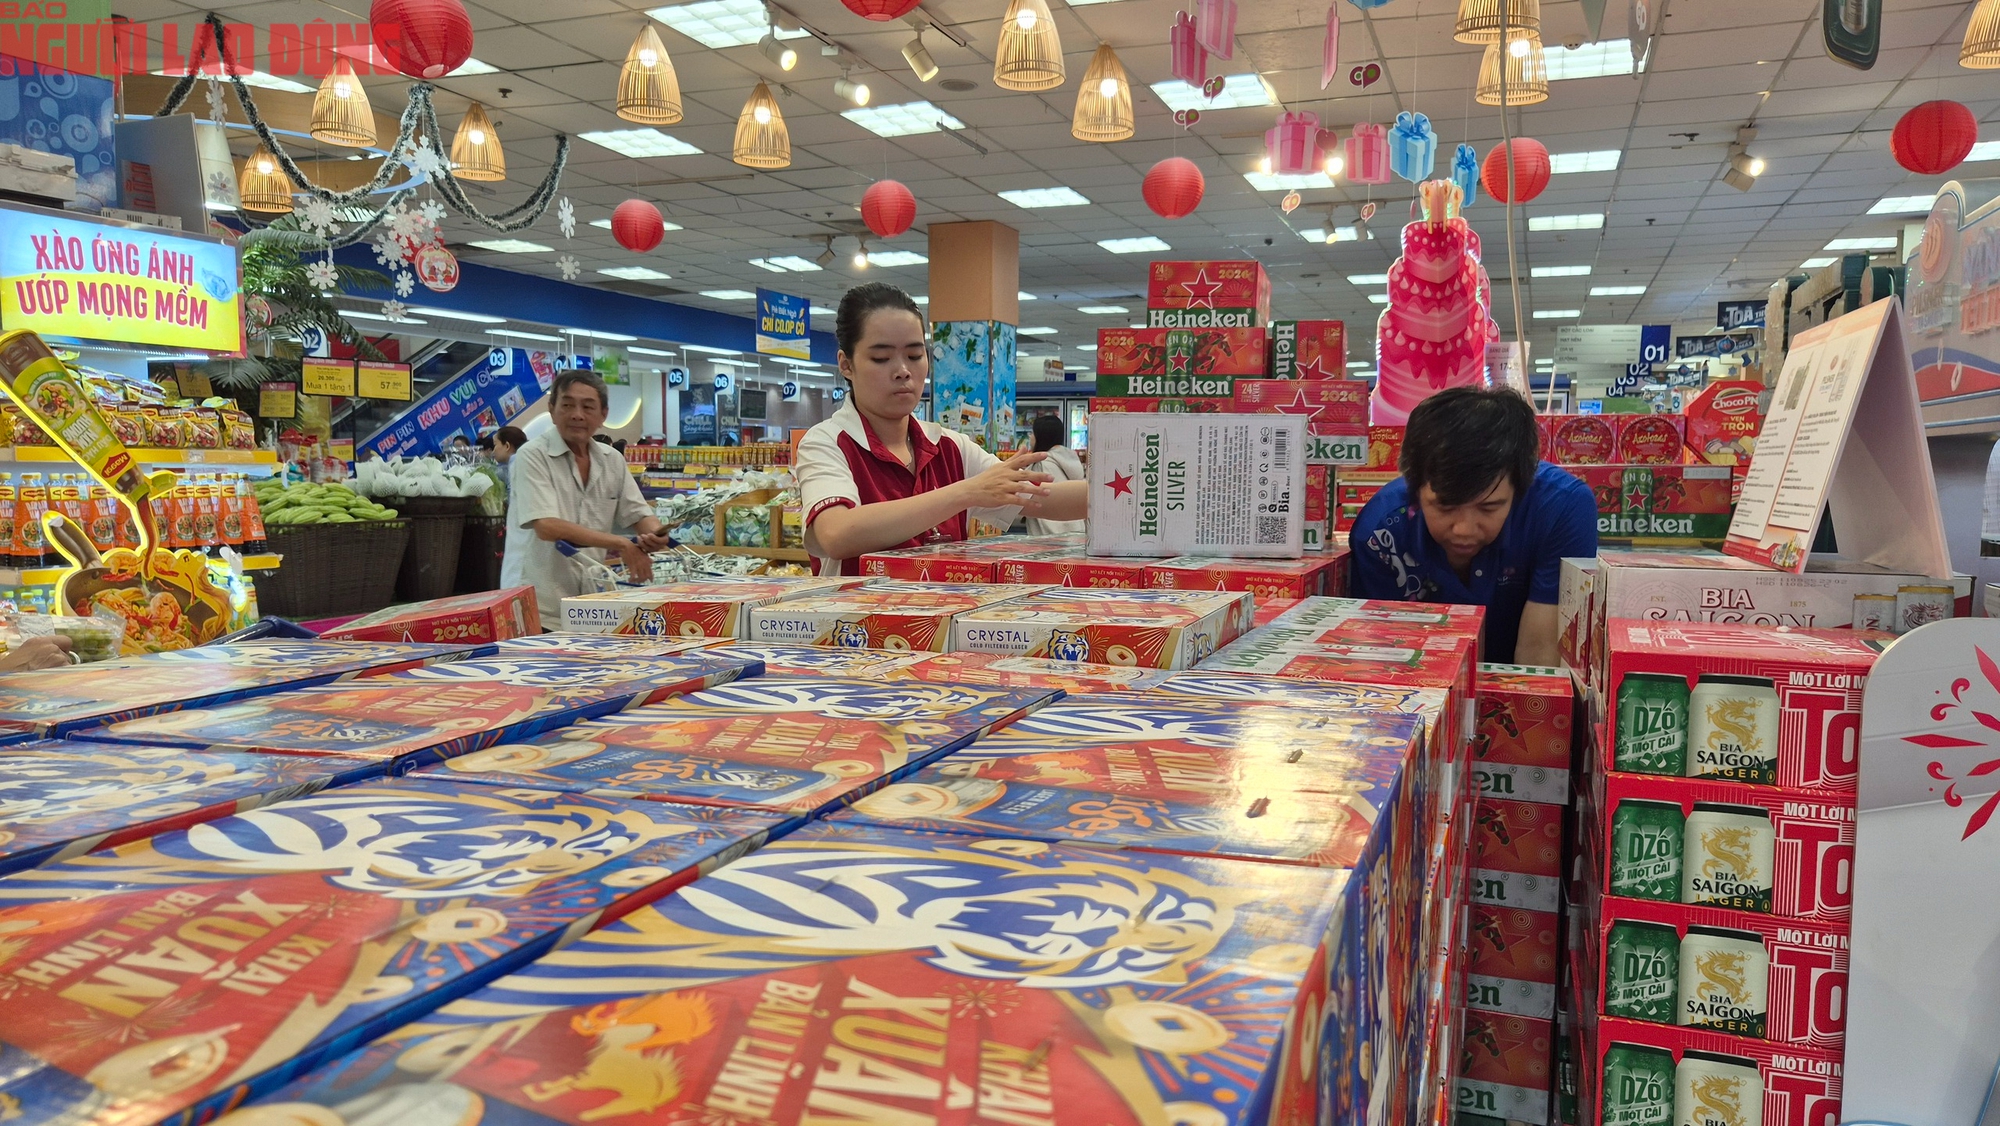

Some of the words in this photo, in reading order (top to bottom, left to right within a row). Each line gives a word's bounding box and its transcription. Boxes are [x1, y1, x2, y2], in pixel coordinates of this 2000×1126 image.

[30, 229, 84, 271] XÀO
[147, 241, 194, 286] ÁNH
[16, 273, 69, 315] ƯỚP
[77, 281, 148, 321] MỌNG
[1149, 309, 1250, 328] Heineken
[490, 352, 504, 367] 03
[1644, 345, 1665, 361] 01
[669, 372, 683, 383] 05
[1629, 363, 1649, 376] 02
[306, 382, 322, 390] Mua
[715, 376, 728, 388] 06
[783, 385, 795, 395] 07
[1127, 376, 1230, 395] Heineken
[1608, 387, 1623, 396] 04
[417, 397, 451, 431] KHU
[450, 378, 478, 405] VUI
[1139, 433, 1160, 537] Heineken
[1167, 460, 1186, 511] SILVER
[1278, 491, 1290, 513] Bia
[866, 560, 877, 572] 24
[1004, 564, 1016, 576] 24
[1089, 577, 1131, 588] 2026
[1152, 571, 1165, 584] 24
[1245, 585, 1291, 597] 2026
[1701, 588, 1755, 610] BIA
[568, 608, 619, 620] CRYSTAL
[432, 622, 481, 642] 2026
[760, 619, 816, 633] CRYSTAL
[967, 629, 1030, 643] CRYSTAL
[984, 642, 1009, 650] FILTERED
[1789, 671, 1825, 689] MỘT
[1827, 673, 1851, 688] LỜI
[1633, 704, 1676, 737] DZÔ
[1720, 743, 1742, 753] BIA
[1697, 750, 1765, 769] SAIGON
[1701, 766, 1759, 779] LAGER
[1784, 802, 1819, 819] MỘT
[1821, 804, 1844, 820] LỜI
[1628, 830, 1670, 863] DZÔ
[1715, 872, 1738, 882] BIA
[1692, 878, 1761, 898] SAIGON
[1696, 893, 1754, 909] LAGER
[118, 890, 217, 931] BẢN
[1777, 928, 1813, 945] MỘT
[1814, 930, 1837, 948] LỜI
[12, 928, 135, 992] LĨNH
[57, 889, 312, 1019] XUÂN
[219, 934, 339, 996] KHAI
[1623, 950, 1666, 983] DZÔ
[747, 978, 829, 1038] BẢN
[1709, 994, 1733, 1005] BIA
[1686, 1000, 1755, 1022] SAIGON
[1690, 1016, 1748, 1032] LAGER
[1772, 1054, 1807, 1072] MỘT
[1808, 1057, 1831, 1075] LỜI
[705, 1034, 805, 1119] LĨNH
[1619, 1071, 1662, 1103] DZÔ
